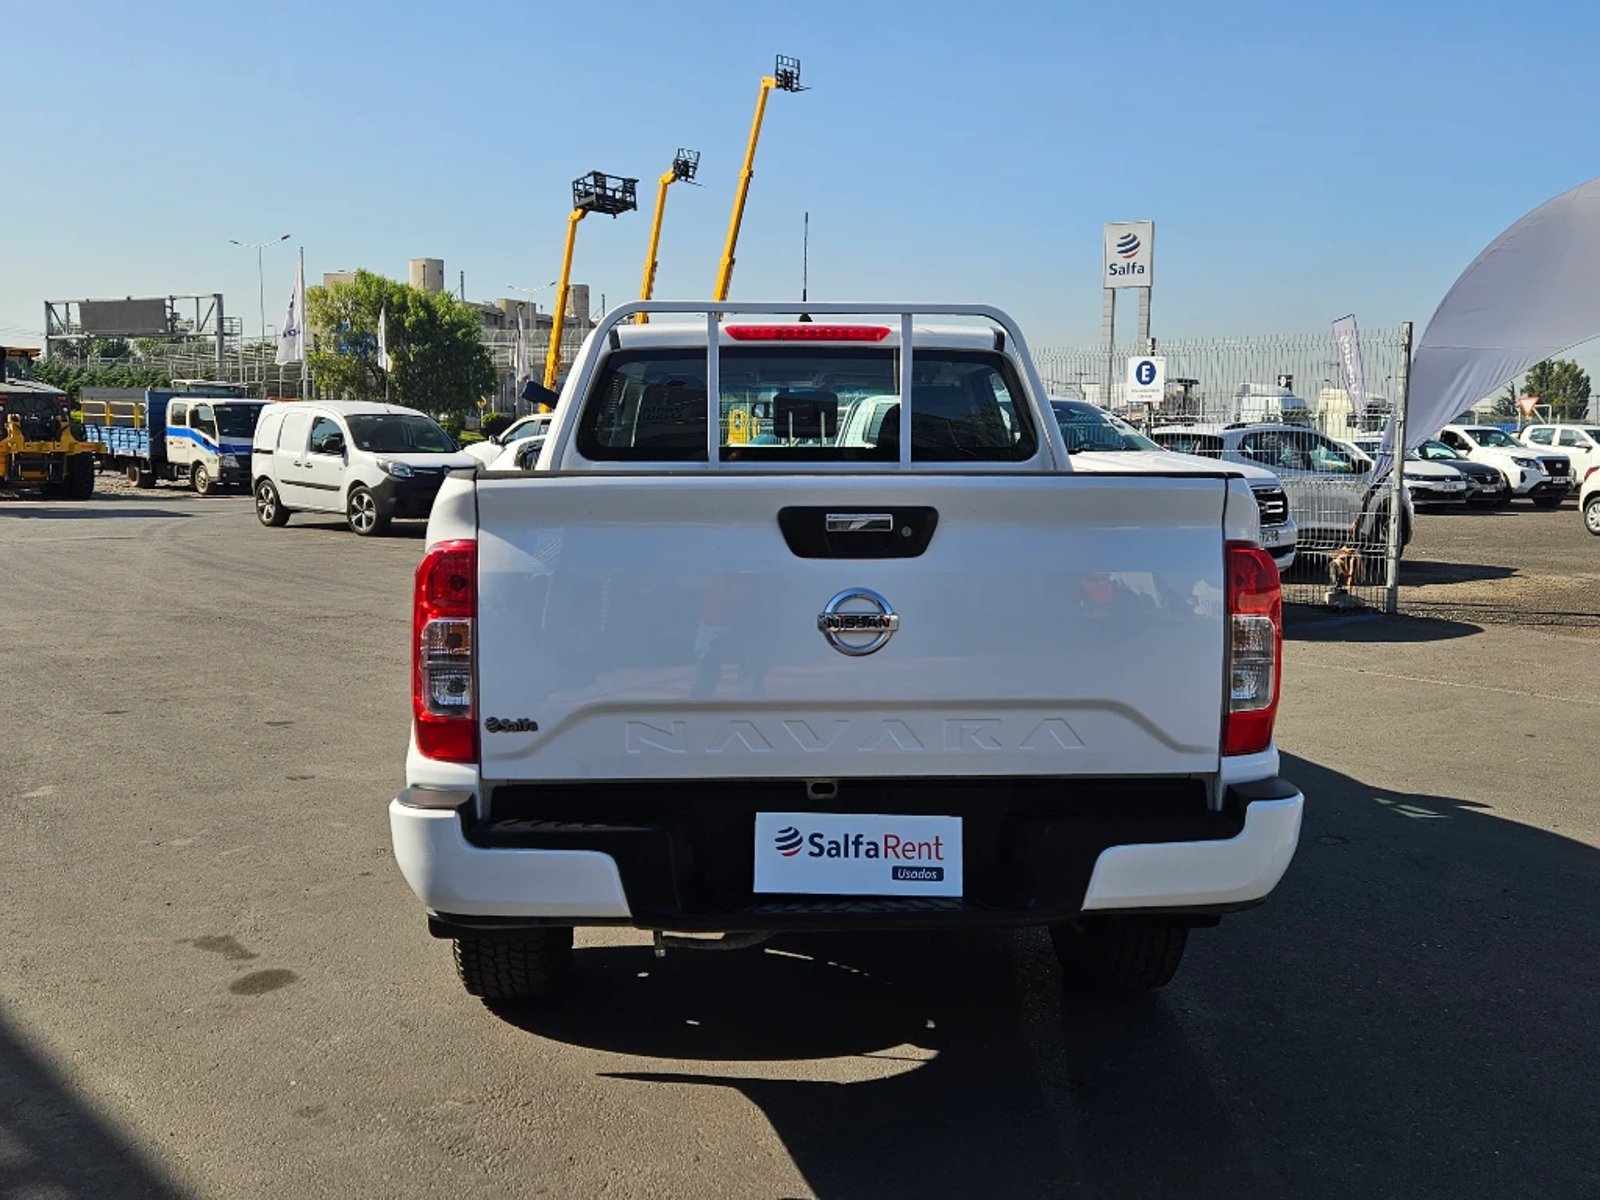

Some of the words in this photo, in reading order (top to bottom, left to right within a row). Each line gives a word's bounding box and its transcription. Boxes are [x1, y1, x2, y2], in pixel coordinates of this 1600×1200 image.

[1108, 261, 1145, 276] Salfa
[1141, 364, 1151, 382] E
[827, 615, 890, 629] NISSAN
[502, 717, 538, 733] Salfa
[625, 718, 1086, 754] NAVARA
[808, 832, 945, 861] SalfaRent
[897, 867, 938, 880] Usados
